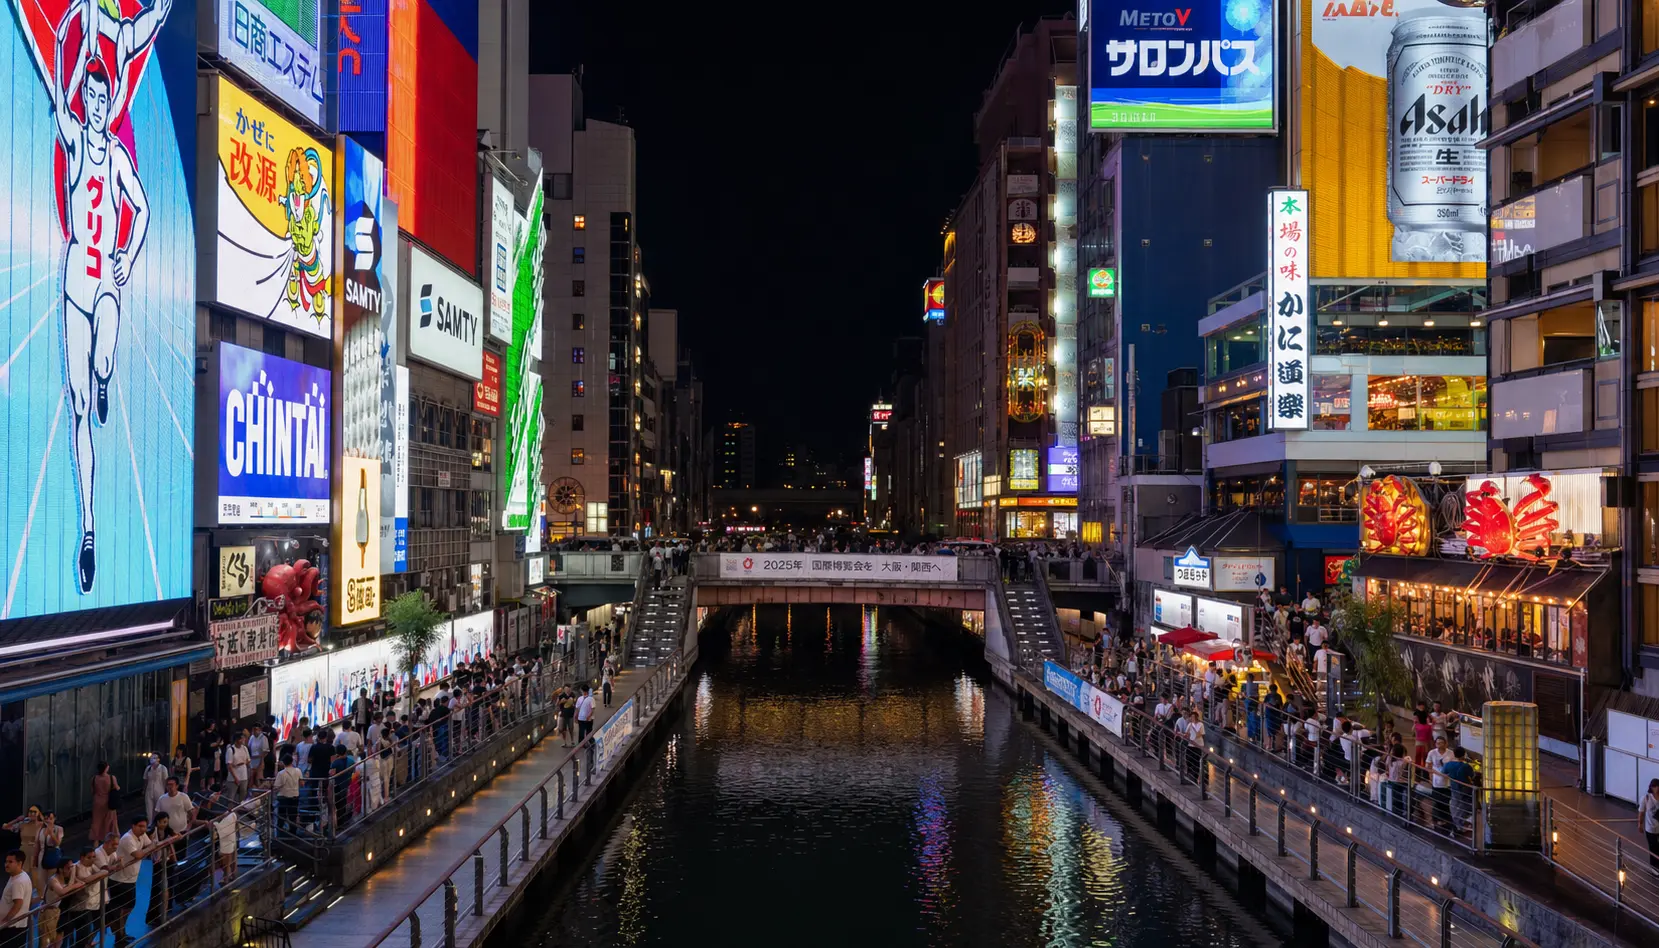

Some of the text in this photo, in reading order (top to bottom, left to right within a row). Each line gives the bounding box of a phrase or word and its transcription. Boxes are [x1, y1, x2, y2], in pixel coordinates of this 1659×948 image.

[1105, 39, 1260, 77] サロンパス
[235, 107, 275, 153] かぜに
[229, 136, 278, 204] 改源
[1421, 175, 1475, 185] スーパードライ
[1435, 148, 1461, 166] 生
[86, 175, 105, 280] グリコ
[1279, 196, 1302, 282] 本場の味
[345, 278, 382, 313] SAMTY
[436, 296, 478, 346] SAMTY
[225, 369, 326, 479] CHINTAI
[763, 560, 803, 571] 2025年
[881, 560, 942, 573] 大阪・関西へ
